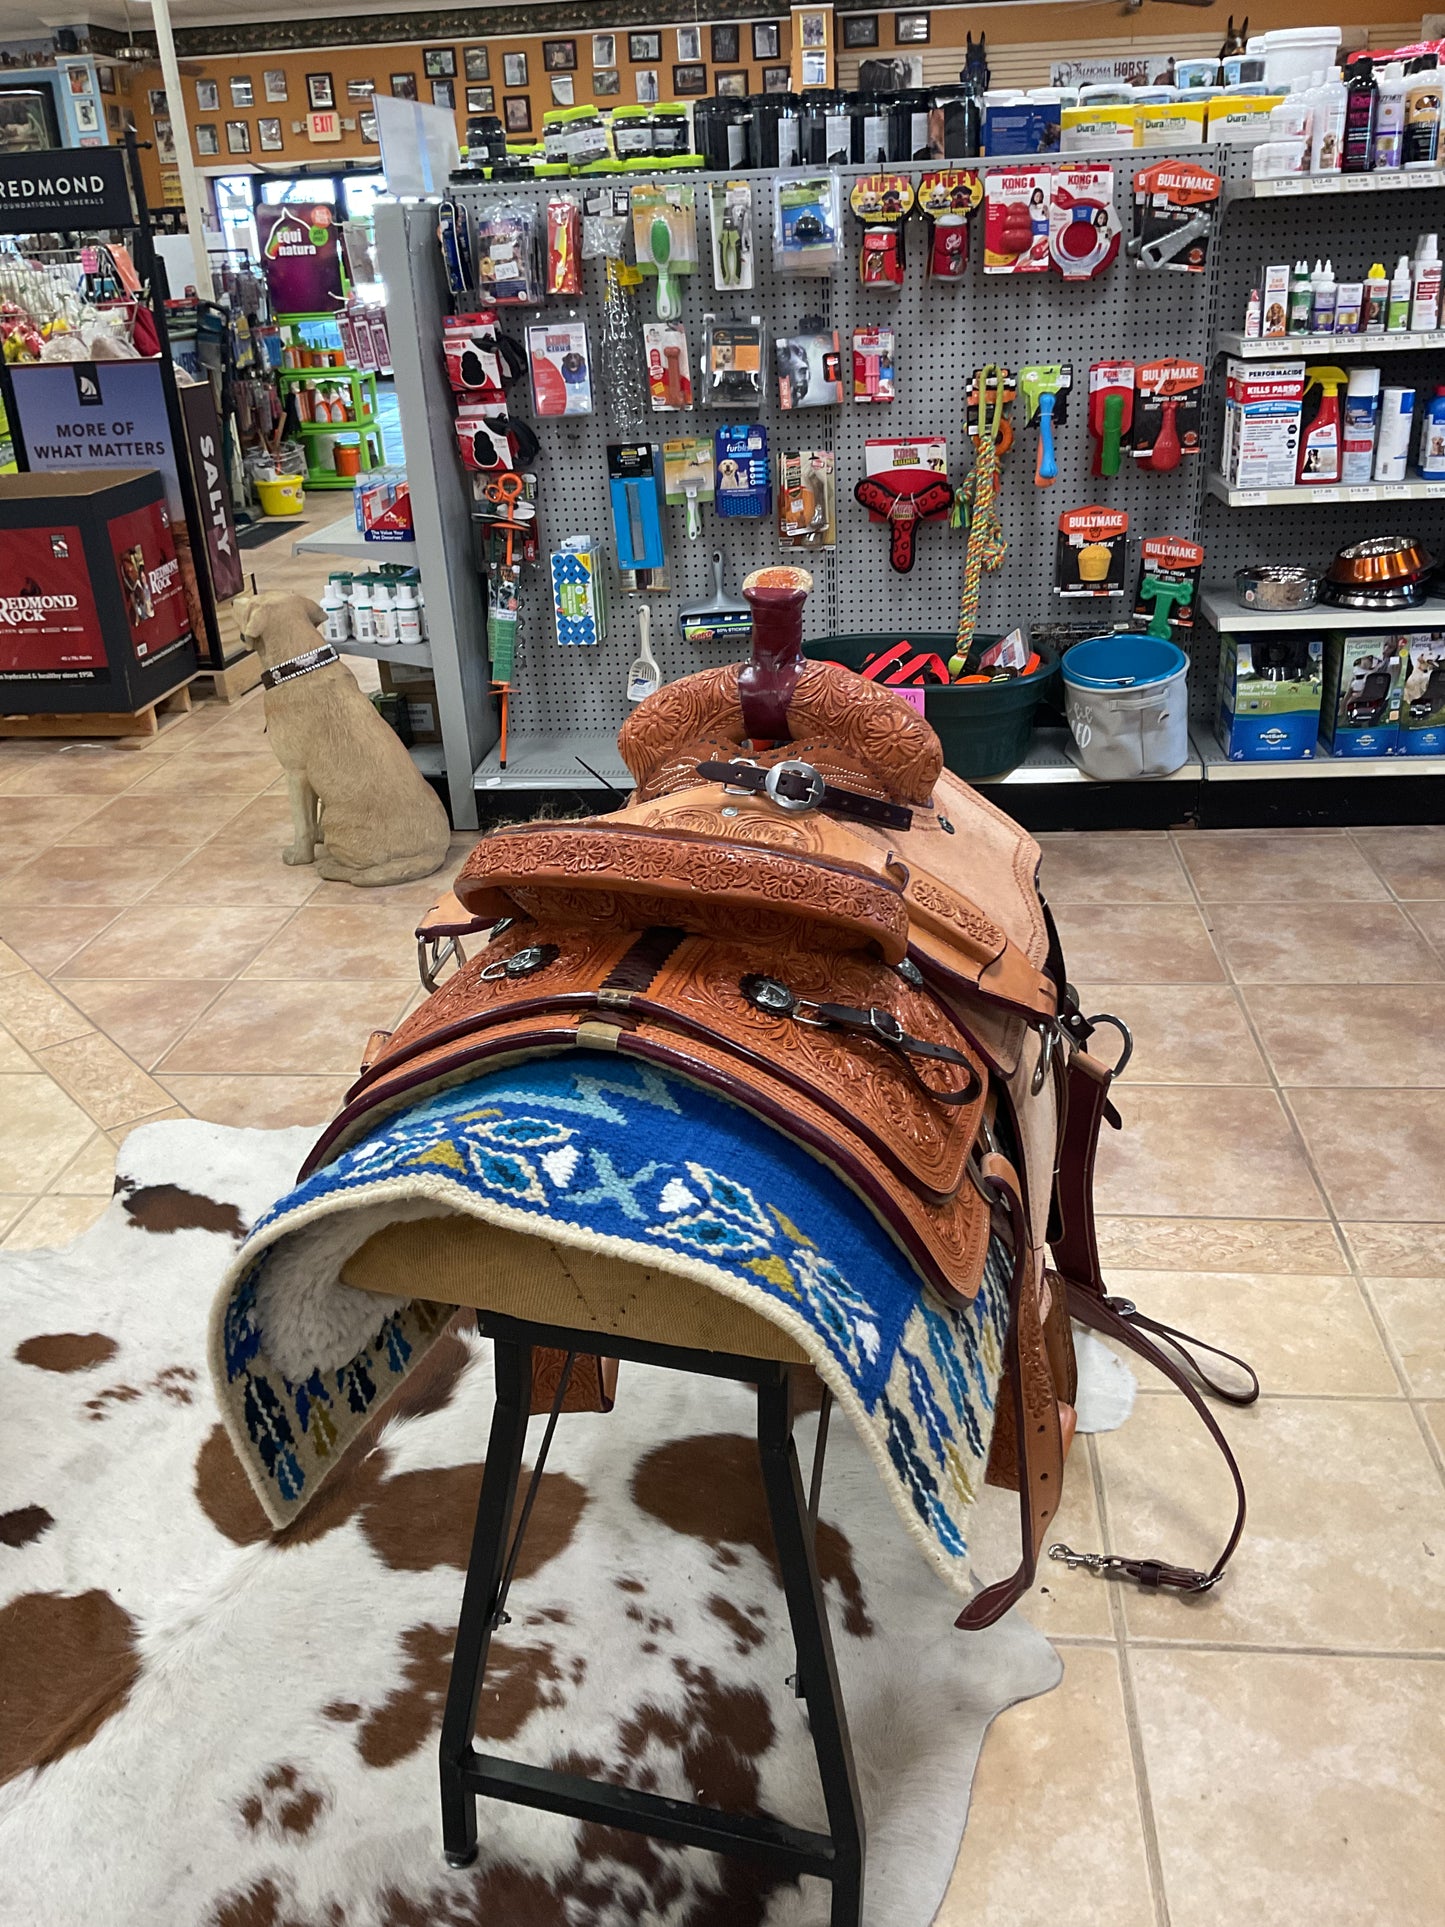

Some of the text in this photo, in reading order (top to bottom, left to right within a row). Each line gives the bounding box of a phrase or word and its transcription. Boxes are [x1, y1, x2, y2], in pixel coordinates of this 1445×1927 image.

[313, 115, 333, 134] EXIT
[1002, 177, 1028, 190] KONG
[1068, 174, 1092, 186] KONG
[1157, 173, 1215, 191] BULLYMAKE
[0, 201, 60, 210] OUNDATIONAL
[278, 244, 317, 256] natura
[1248, 369, 1303, 378] PERFORMACIDE
[1247, 385, 1270, 395] KILLS
[56, 421, 135, 439] MORE OF
[34, 441, 165, 460] WHAT MATTERS
[199, 435, 232, 557] SALTY
[1069, 515, 1123, 528] BULLYMAKE
[1145, 542, 1197, 559] BULLYMAKE
